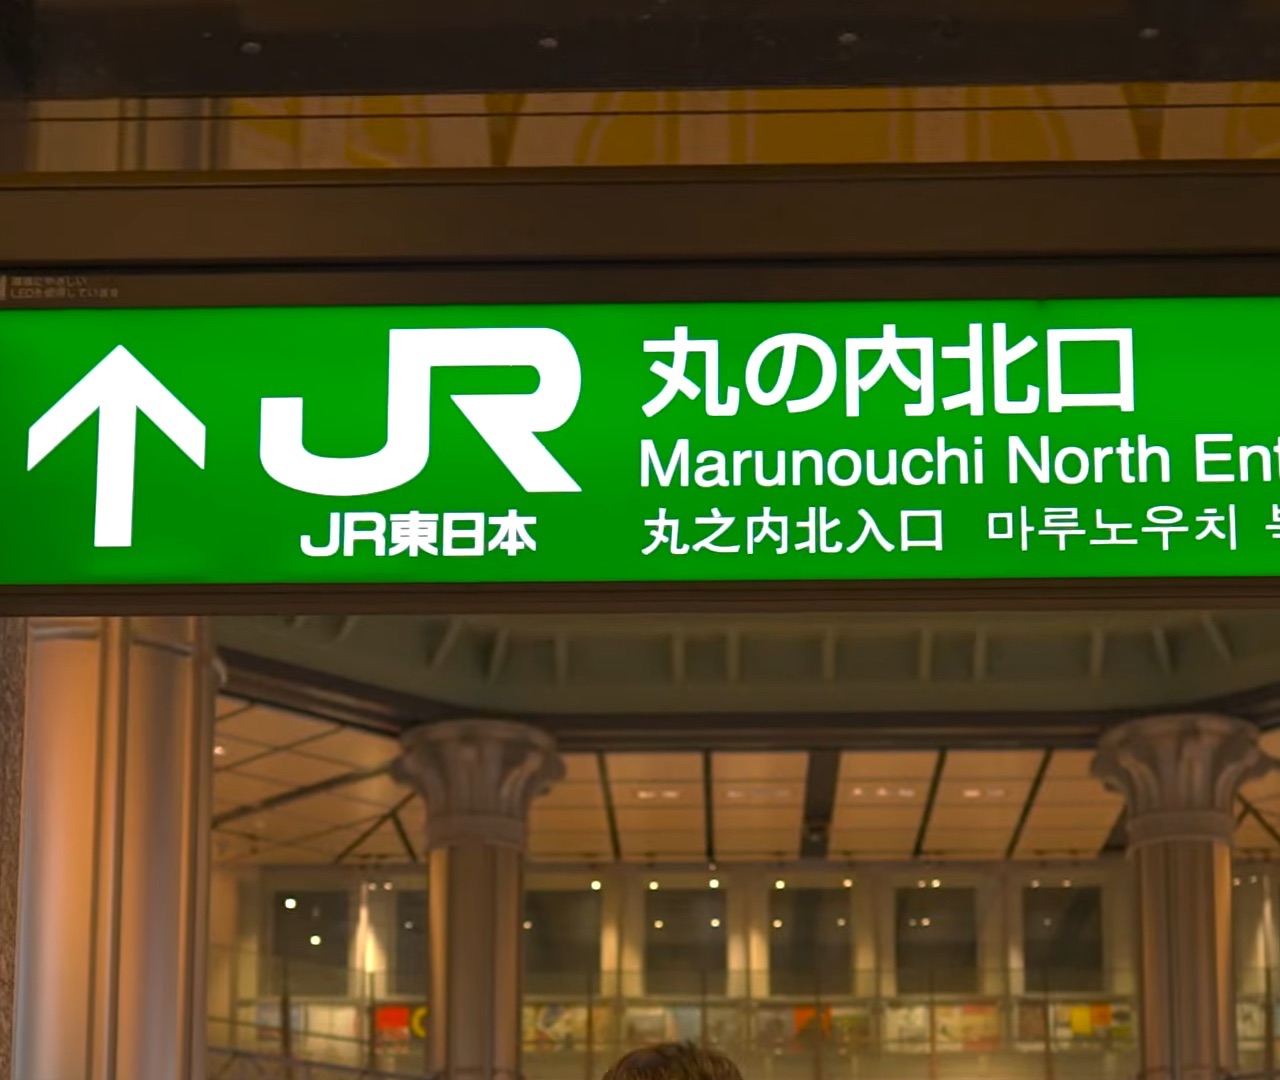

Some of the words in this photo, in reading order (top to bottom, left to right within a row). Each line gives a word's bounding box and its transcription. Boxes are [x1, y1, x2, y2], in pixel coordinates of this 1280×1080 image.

[641, 322, 1135, 418] 丸の内北口
[260, 328, 581, 496] JR
[640, 436, 984, 488] Marunouchi
[1008, 434, 1171, 485] North
[300, 508, 537, 558] JR東日本
[641, 507, 943, 556] 丸之内北入口
[987, 503, 1237, 552] 마루노우치
